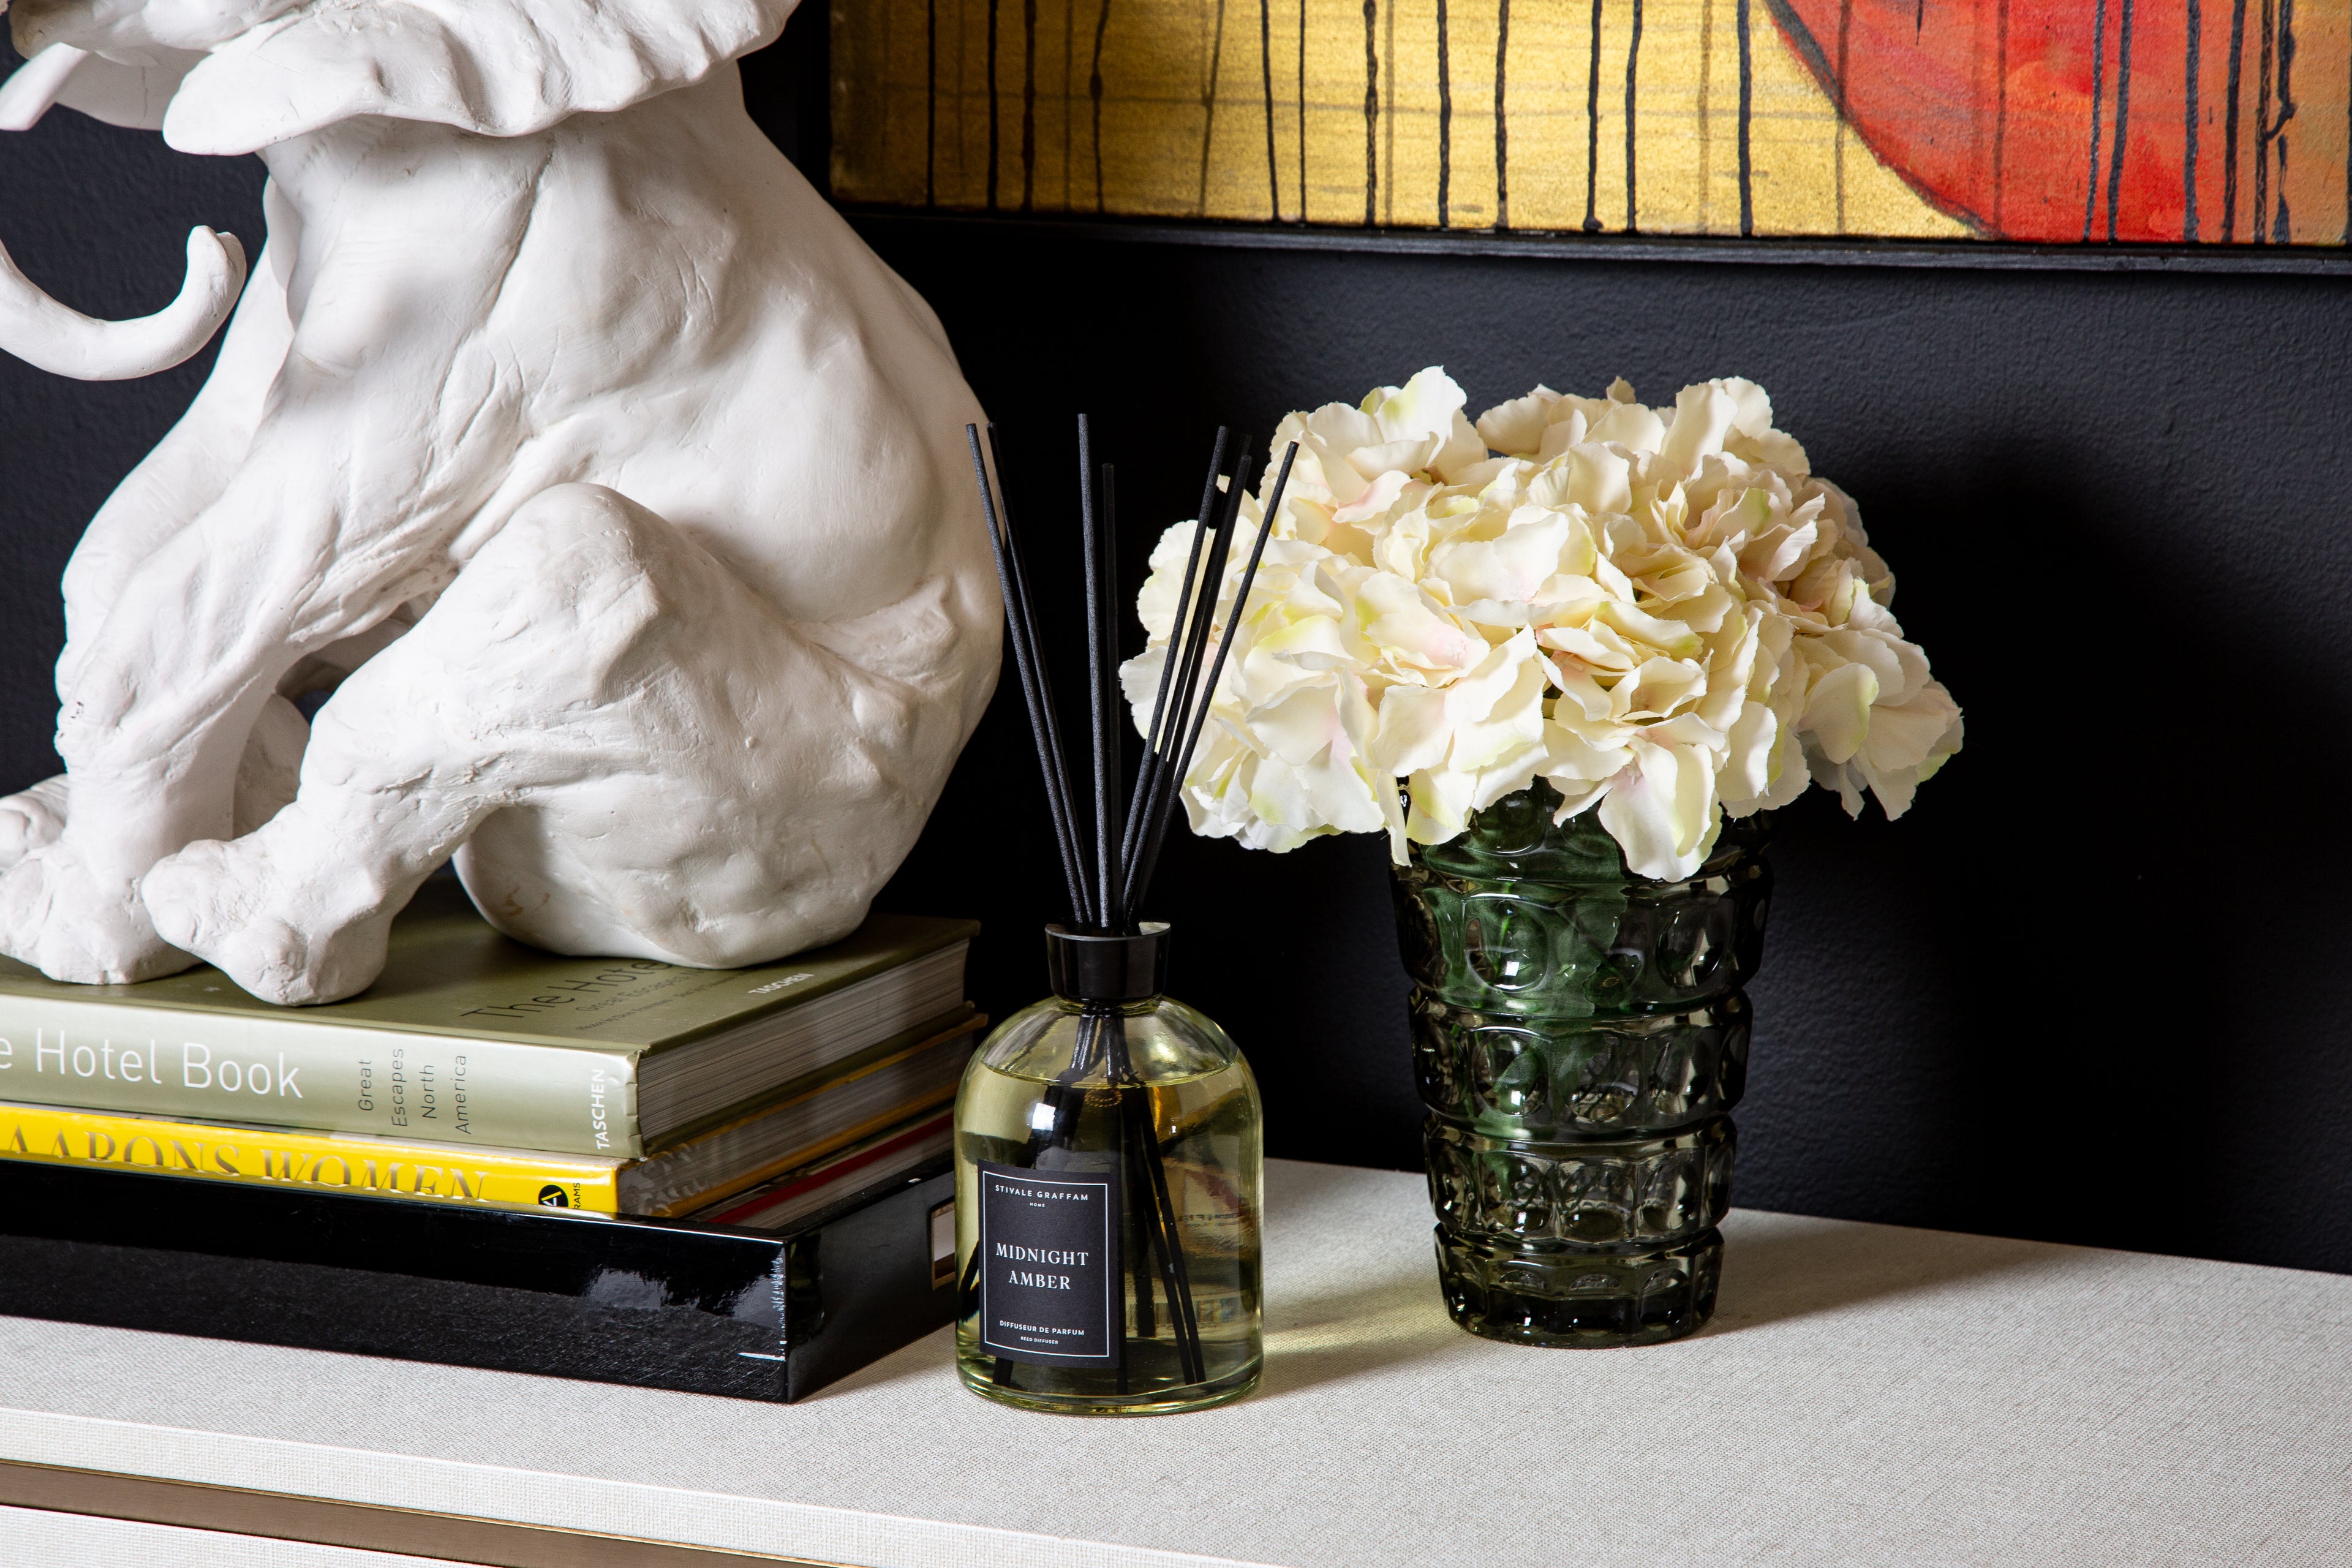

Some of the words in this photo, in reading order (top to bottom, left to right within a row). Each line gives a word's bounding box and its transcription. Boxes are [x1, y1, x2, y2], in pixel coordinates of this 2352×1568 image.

[461, 995, 575, 1018] The
[748, 973, 815, 994] TASCHEN
[36, 1028, 162, 1085] Hotel
[183, 1041, 303, 1098] Book
[358, 1060, 374, 1111] Great
[391, 1049, 407, 1126] Escapes
[419, 1065, 437, 1118] North
[450, 1055, 471, 1134] America
[591, 1068, 611, 1150] TASCHEN
[260, 1149, 490, 1202] WOMEN
[995, 1185, 1033, 1197] STIVALE
[1037, 1191, 1088, 1200] GRAFFAM
[996, 1243, 1088, 1265] MIDNIGHT
[1008, 1270, 1071, 1289] AMBER
[1000, 1320, 1037, 1332] DIFFUSEUR
